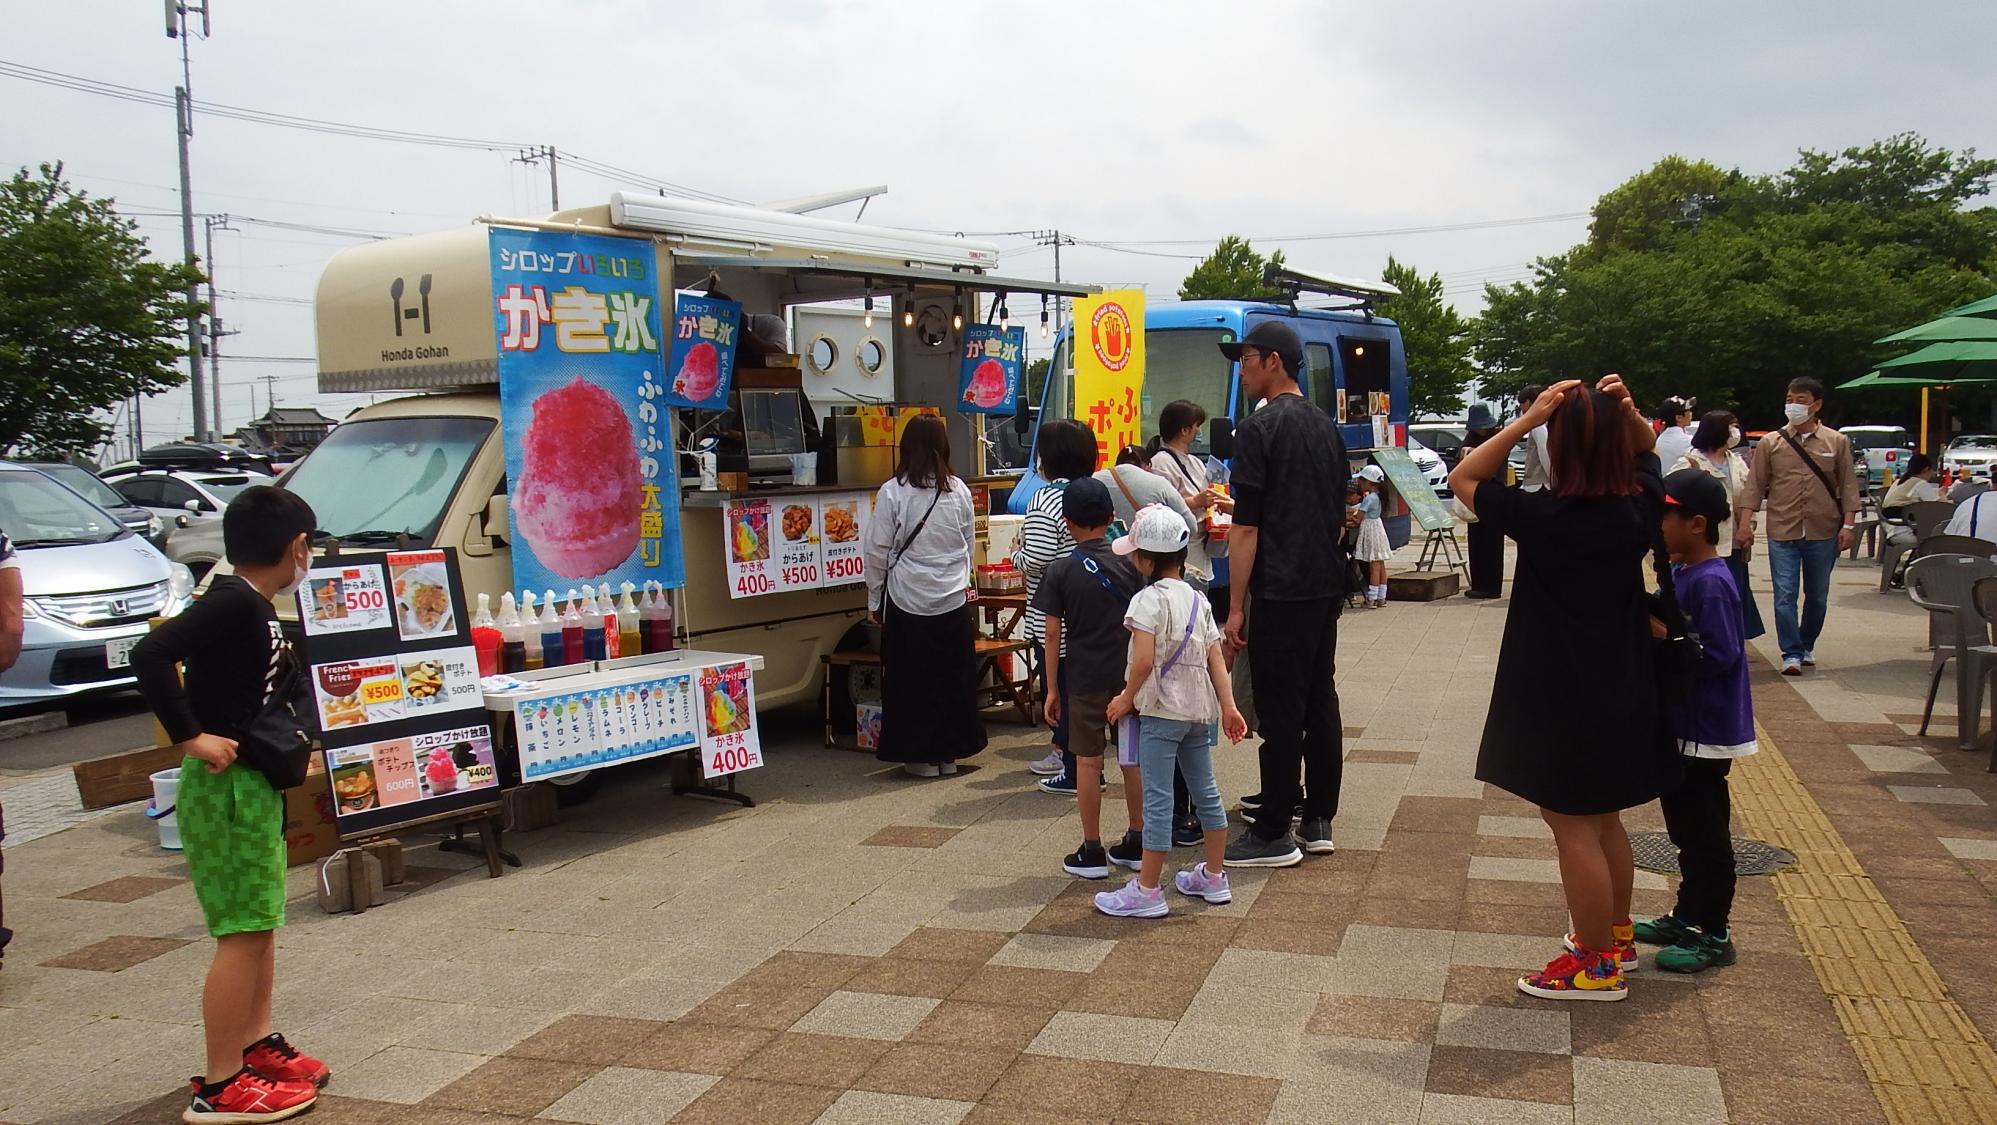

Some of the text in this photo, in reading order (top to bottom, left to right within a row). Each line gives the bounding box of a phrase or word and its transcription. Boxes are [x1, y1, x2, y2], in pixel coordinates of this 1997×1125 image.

[499, 247, 645, 280] シロップいろいろ
[496, 284, 658, 354] かき氷
[678, 314, 735, 346] かき氷
[381, 345, 449, 361] Honda Gohan
[965, 337, 1018, 362] かき氷
[637, 370, 663, 567] ふわふわ大盛り
[740, 562, 765, 573] かき氷
[783, 551, 814, 565] からあげ
[826, 556, 863, 578] ¥500
[343, 578, 376, 590] からあげ
[737, 574, 776, 595] 400円
[782, 565, 817, 585] ¥500
[346, 590, 384, 610] 500
[329, 674, 352, 683] Fries
[453, 669, 473, 678] ポテト
[698, 669, 752, 686] シロップかけ放題
[367, 684, 399, 699] ¥500
[451, 684, 476, 695] 500円
[616, 707, 626, 735] コーラ
[629, 705, 638, 733] マンゴー
[642, 702, 651, 730] グレープ
[656, 700, 664, 727] ピーチ
[668, 698, 677, 724] みぞれ
[556, 717, 565, 747] メロン
[571, 715, 581, 744] レモン
[602, 709, 612, 737] ラムネ
[415, 726, 489, 747] シロップかけ放題
[540, 720, 549, 750] いちご
[715, 733, 745, 748] かき氷
[377, 757, 400, 766] ポテト
[386, 760, 415, 773] チップス
[712, 746, 758, 773] 400円
[468, 766, 492, 777] ¥400
[386, 778, 415, 792] 600円
